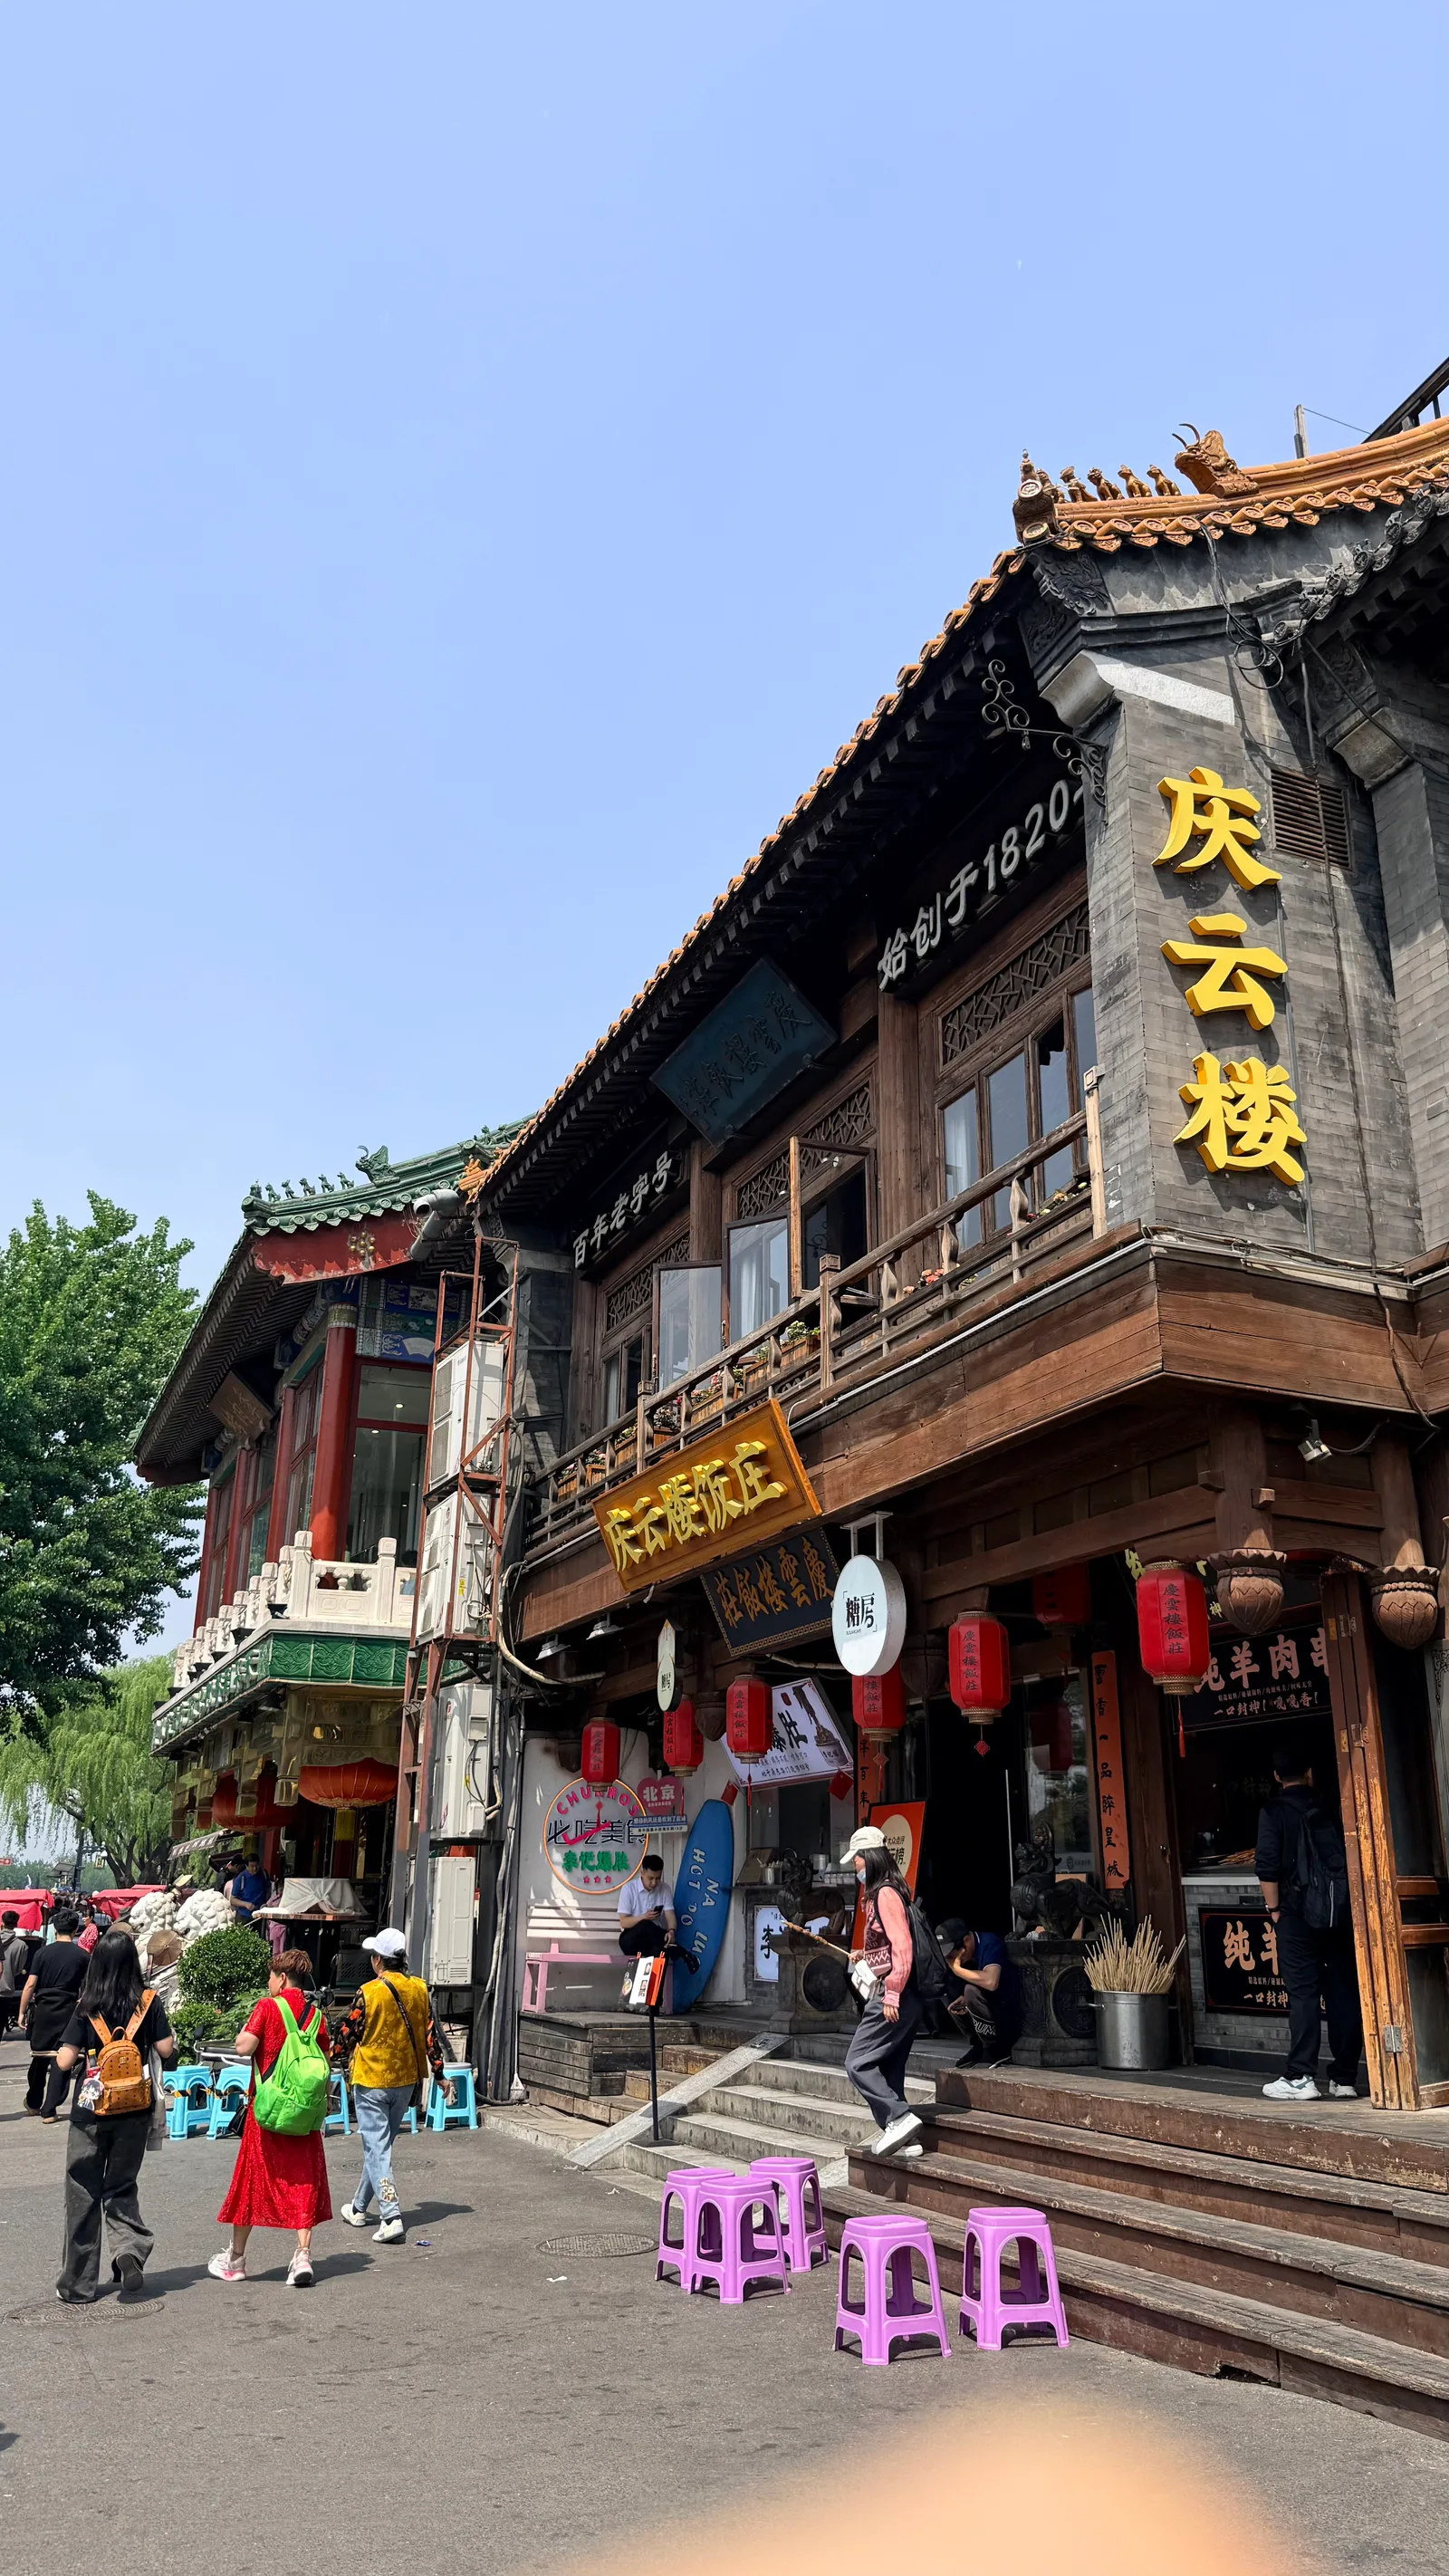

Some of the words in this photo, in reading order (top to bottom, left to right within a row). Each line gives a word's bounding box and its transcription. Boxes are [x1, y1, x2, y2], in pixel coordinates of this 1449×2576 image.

[878, 780, 1083, 991] 始创于1820
[1152, 766, 1307, 1186] 庆云楼
[573, 1151, 672, 1268] 百年老字号
[605, 1441, 787, 1572] 庆云楼饭庄
[846, 1592, 876, 1629] 糖房
[1163, 1583, 1185, 1654] 慶雲樓飯莊
[865, 1676, 878, 1713] 樓飯莊
[643, 1784, 676, 1802] 北京
[547, 1819, 646, 1845] 必吃美食
[561, 1850, 629, 1872] 李记爆肚
[688, 1848, 705, 1890] HOT
